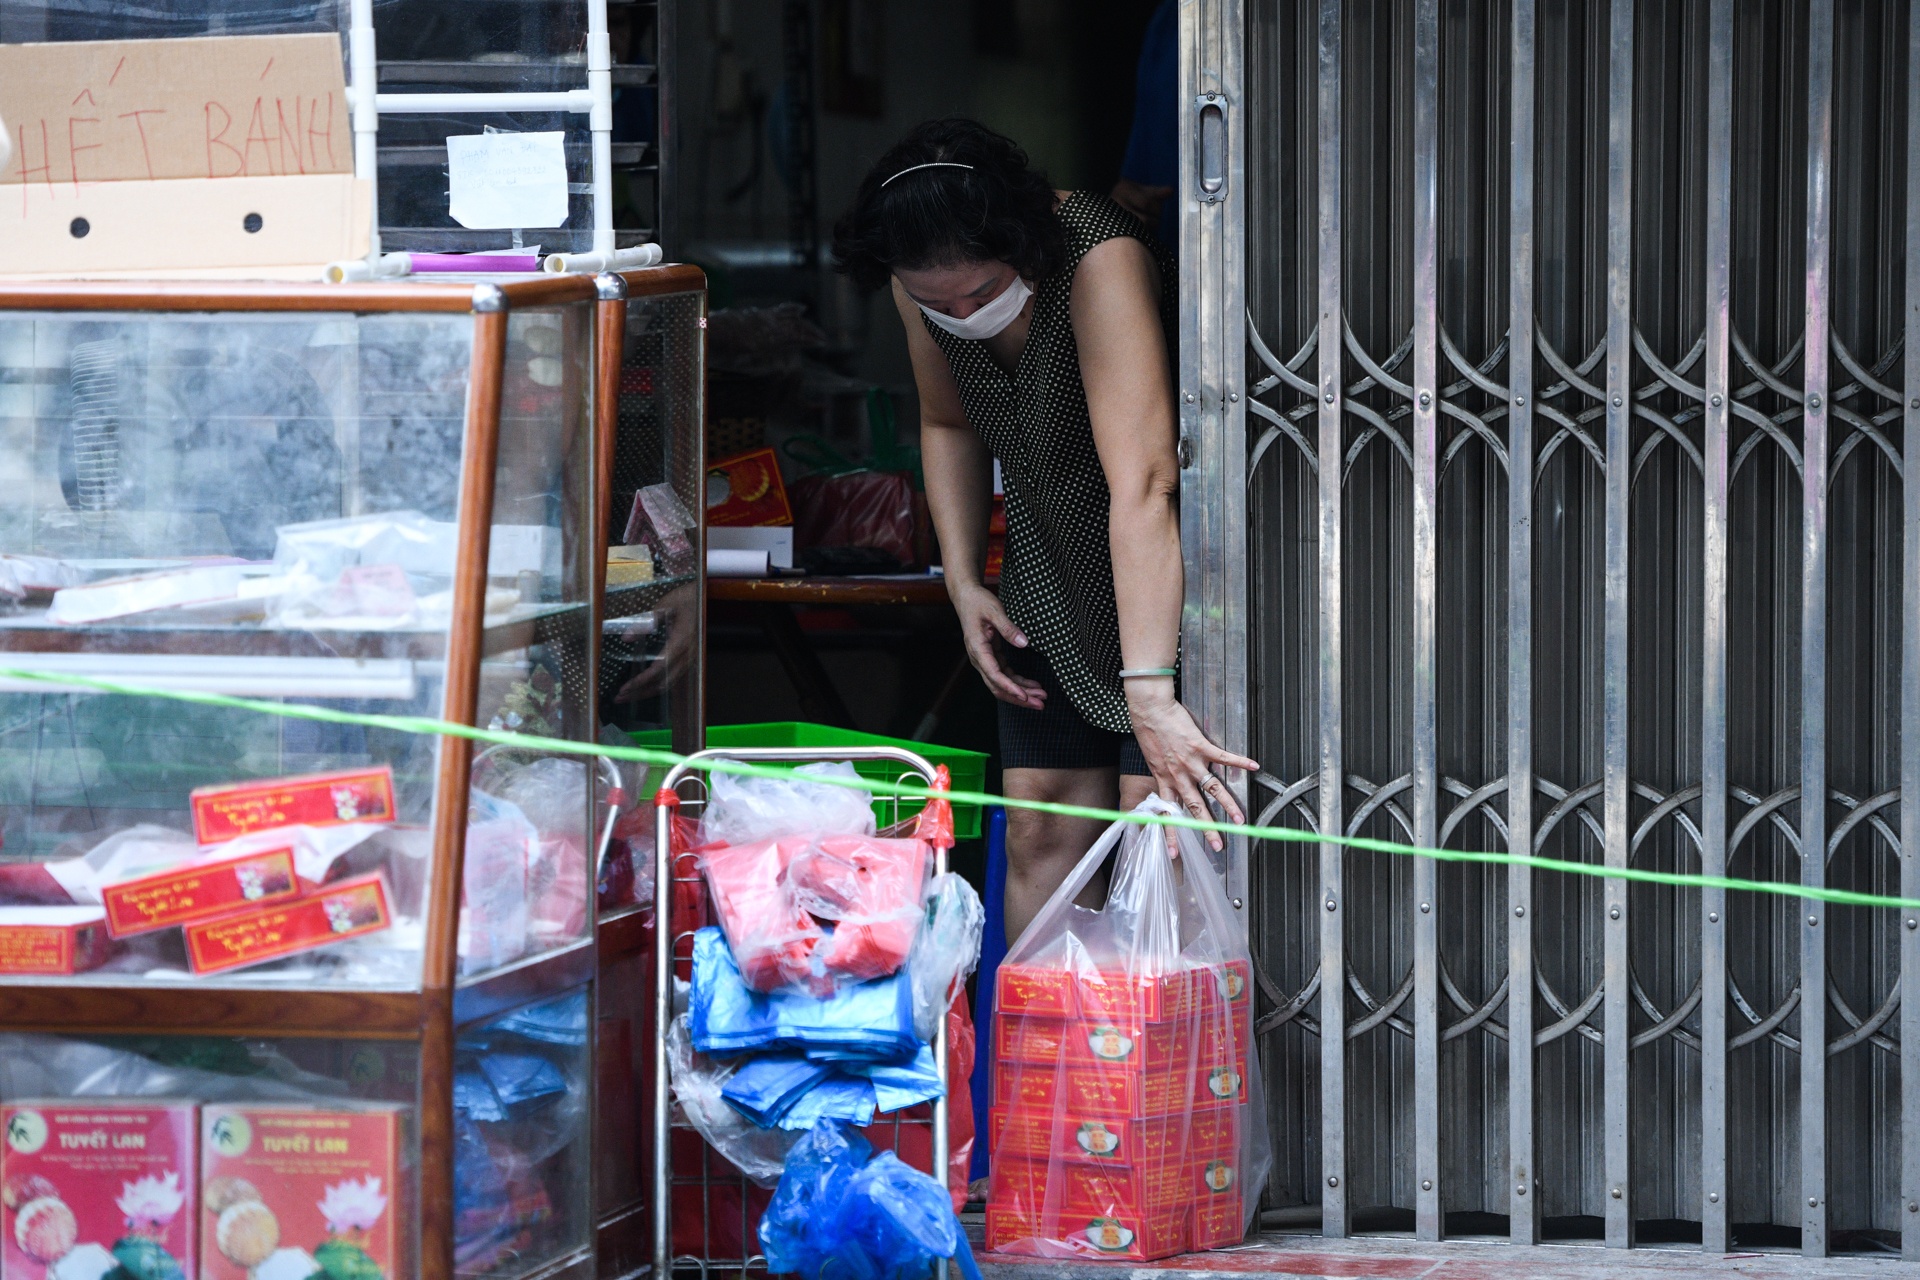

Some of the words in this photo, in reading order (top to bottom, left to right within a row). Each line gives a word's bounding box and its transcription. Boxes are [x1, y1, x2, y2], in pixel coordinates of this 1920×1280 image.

[15, 56, 168, 218] HẾT
[204, 56, 336, 179] BÁNH
[59, 1128, 108, 1149] TUYẾT
[112, 1133, 146, 1149] LAN
[262, 1132, 310, 1153] TUYẾT
[314, 1137, 349, 1153] LAN
